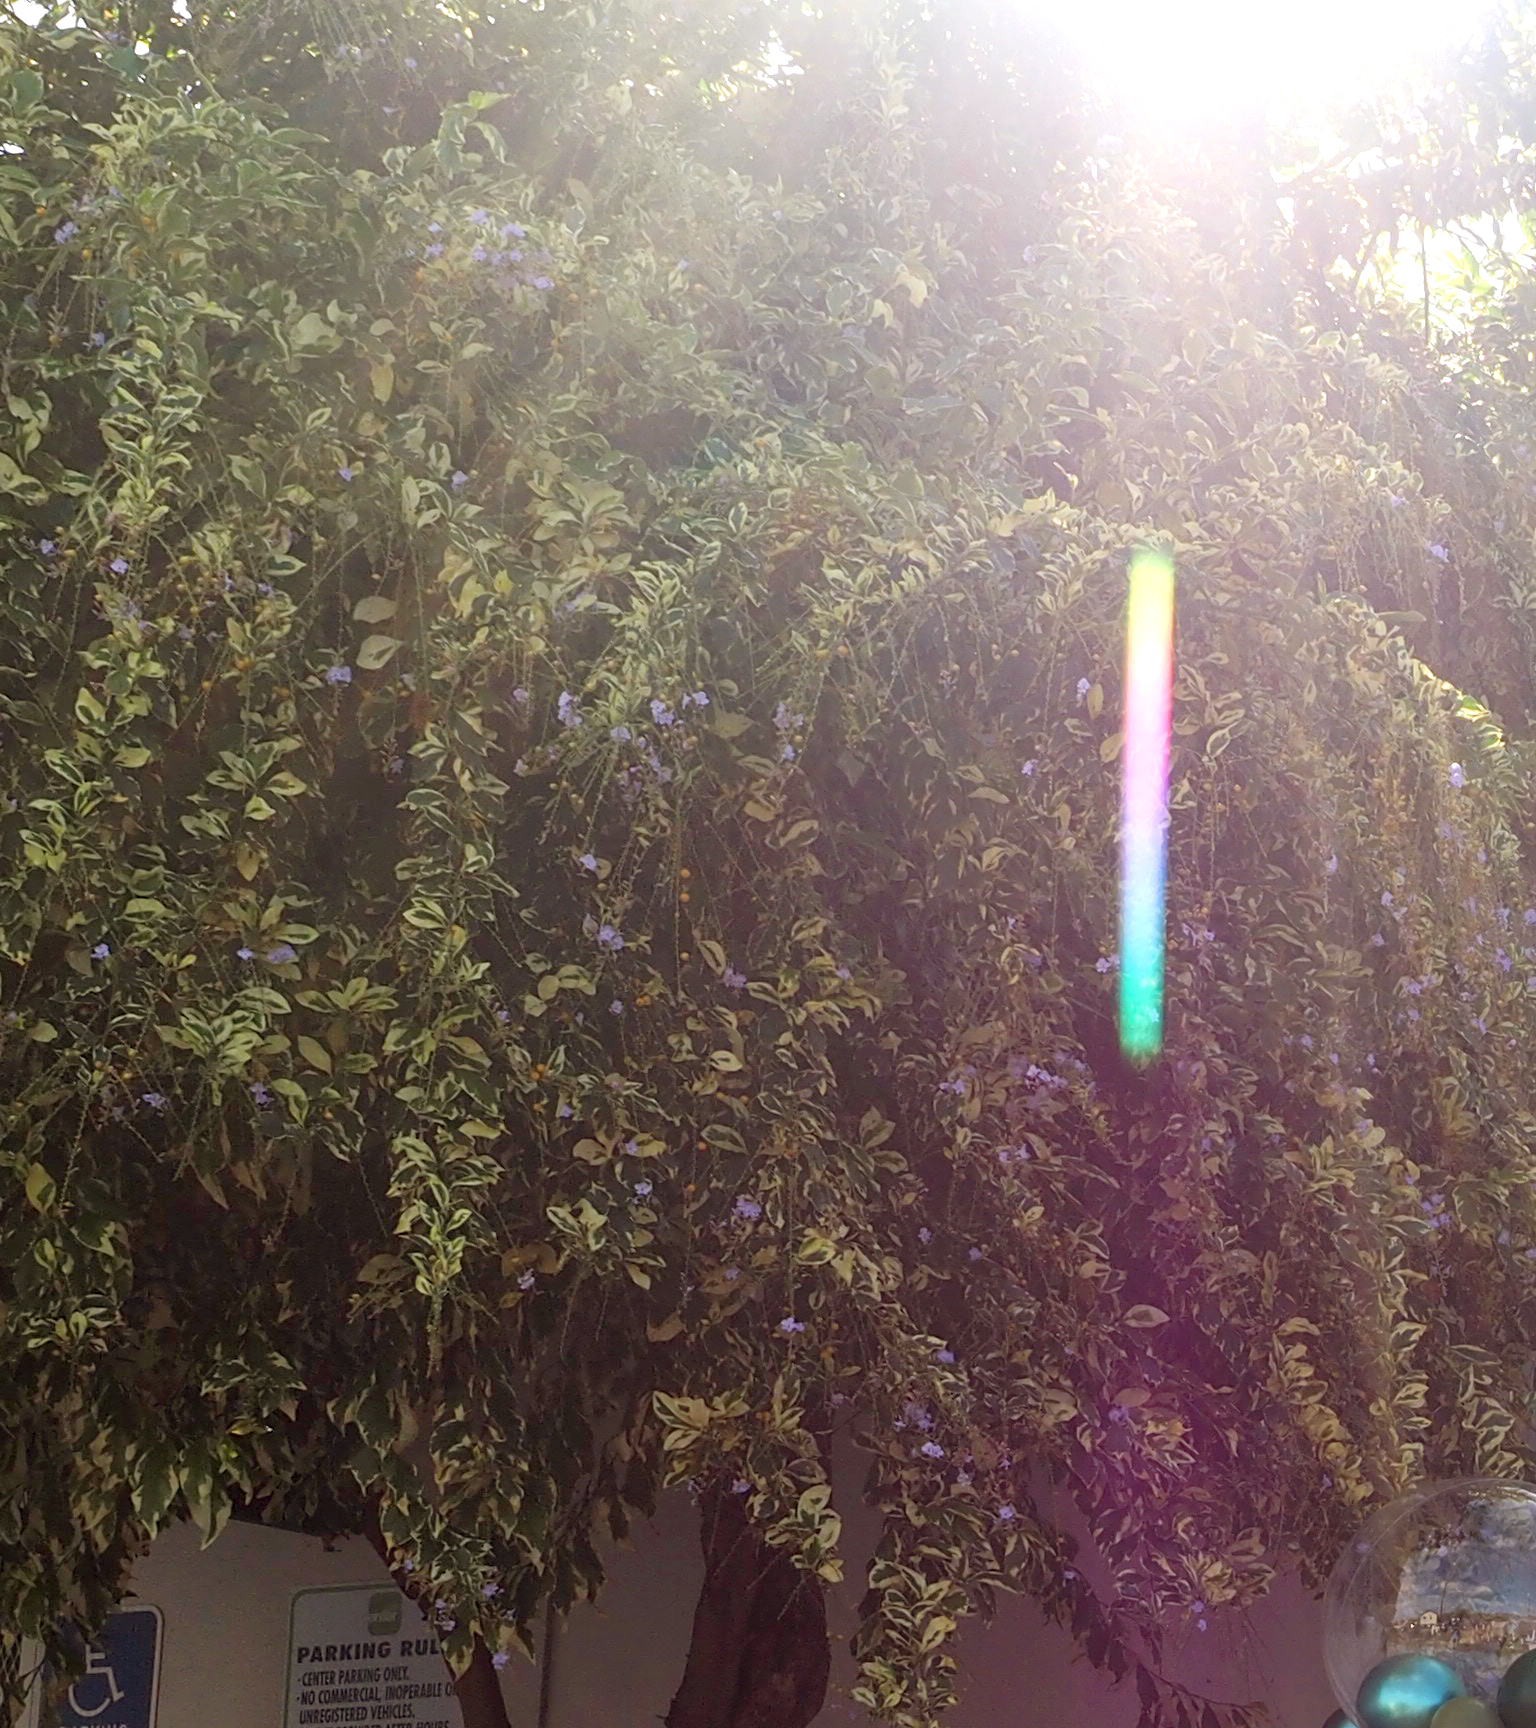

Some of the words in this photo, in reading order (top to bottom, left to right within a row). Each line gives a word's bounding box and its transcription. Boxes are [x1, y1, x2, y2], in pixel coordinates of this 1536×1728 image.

[297, 1641, 391, 1663] PARKING
[302, 1671, 336, 1686] CENTER
[338, 1667, 380, 1685] PARKING
[384, 1666, 409, 1681] ONLY.
[301, 1690, 315, 1705] NO
[385, 1683, 441, 1699] INOPERABLE
[299, 1707, 367, 1725] UNREGISTERED
[370, 1704, 415, 1720] VEHICLES.
